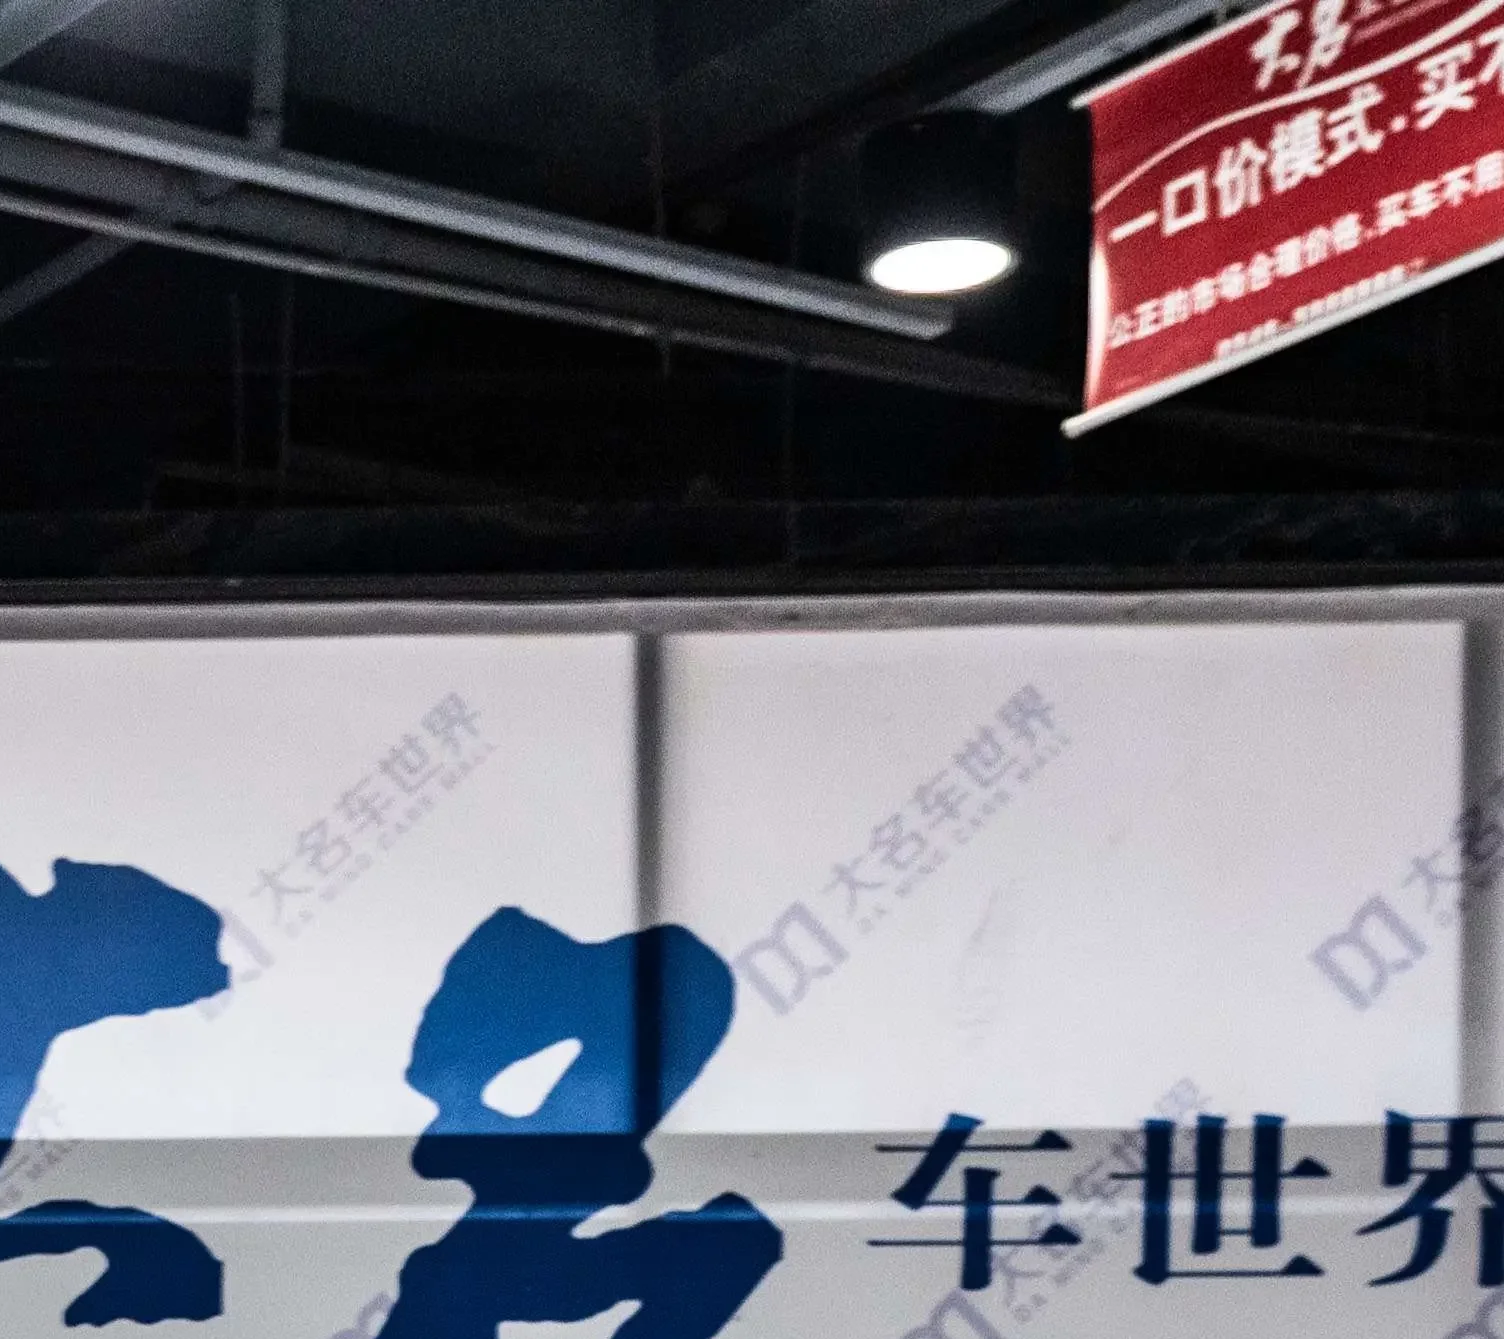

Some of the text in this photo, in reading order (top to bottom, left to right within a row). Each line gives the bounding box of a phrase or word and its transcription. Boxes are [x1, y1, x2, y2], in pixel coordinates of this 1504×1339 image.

[250, 693, 479, 923] 大名车世界
[823, 686, 1056, 916] 大名车世界
